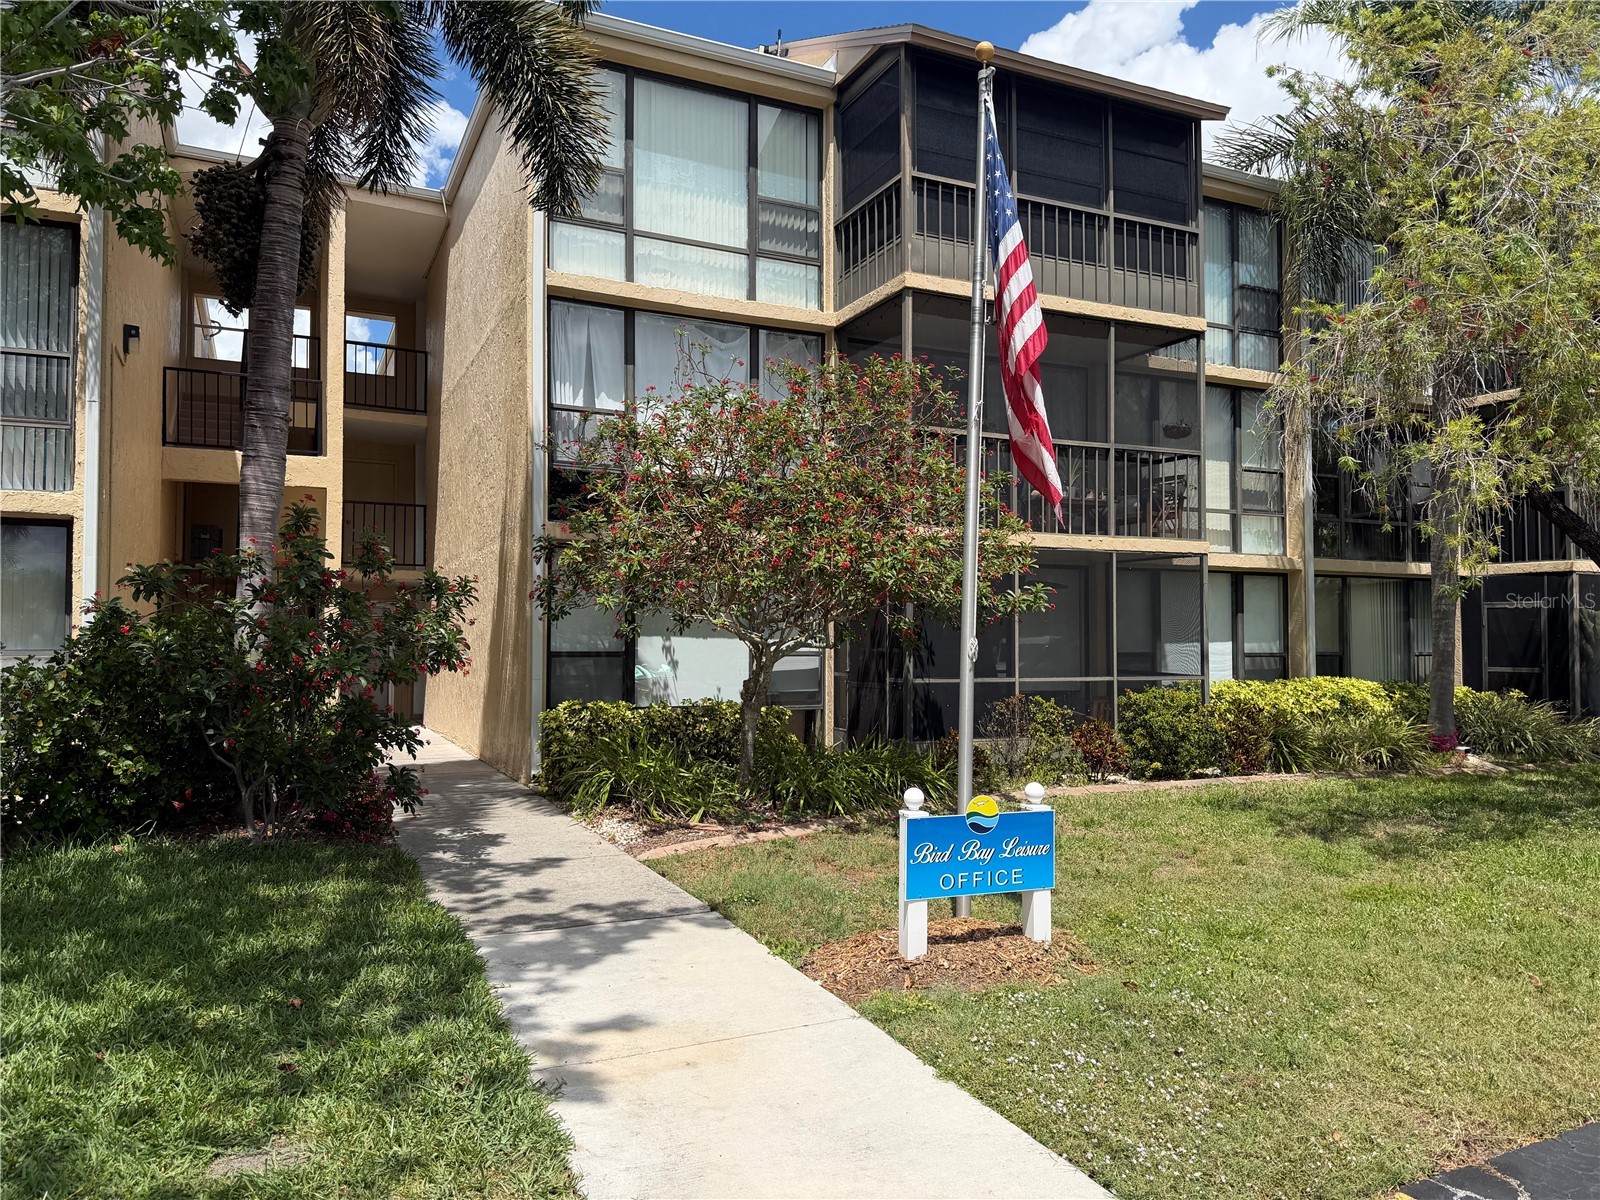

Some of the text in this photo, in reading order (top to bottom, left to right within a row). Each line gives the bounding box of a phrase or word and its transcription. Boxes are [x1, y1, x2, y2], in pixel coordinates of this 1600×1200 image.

[910, 837, 1051, 866] Bird Bay Leisure
[939, 868, 1024, 891] OFFICE
